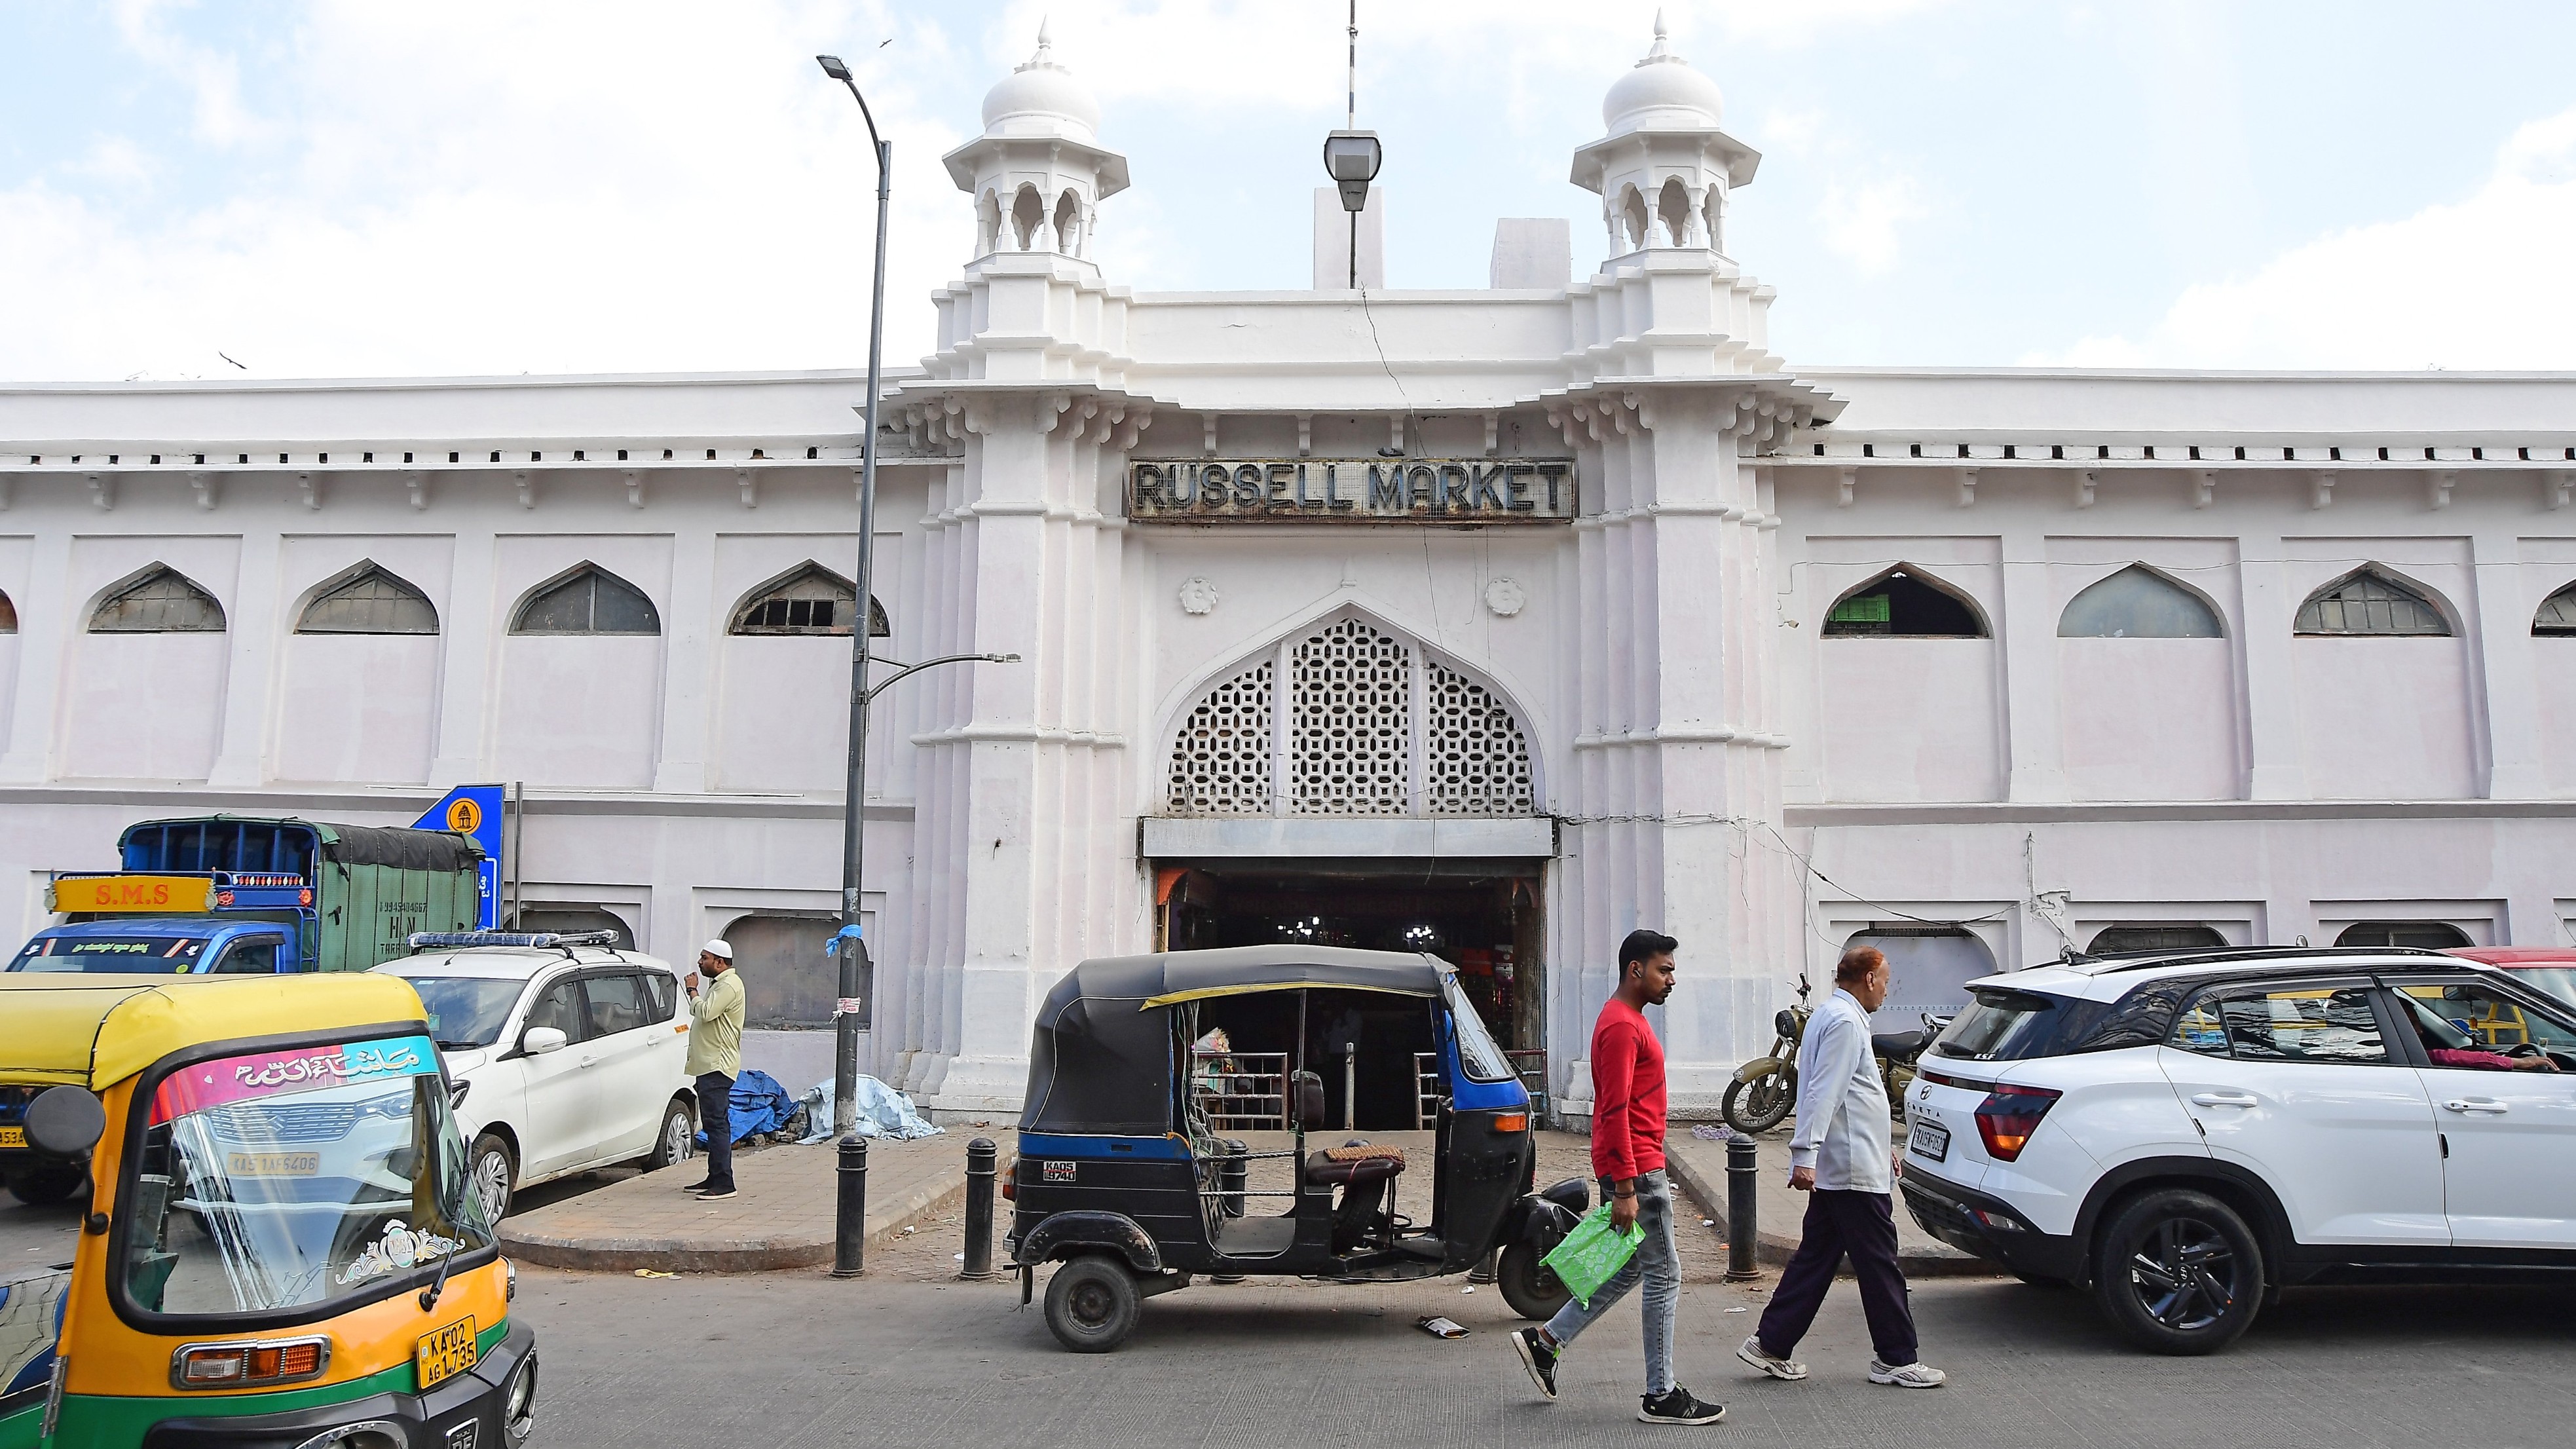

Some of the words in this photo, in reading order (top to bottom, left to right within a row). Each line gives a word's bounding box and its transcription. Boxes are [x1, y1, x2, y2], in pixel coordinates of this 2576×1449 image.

[1136, 464, 1353, 508] RUSSELL
[1370, 464, 1566, 510] MARKET
[96, 884, 168, 905] S.M.S
